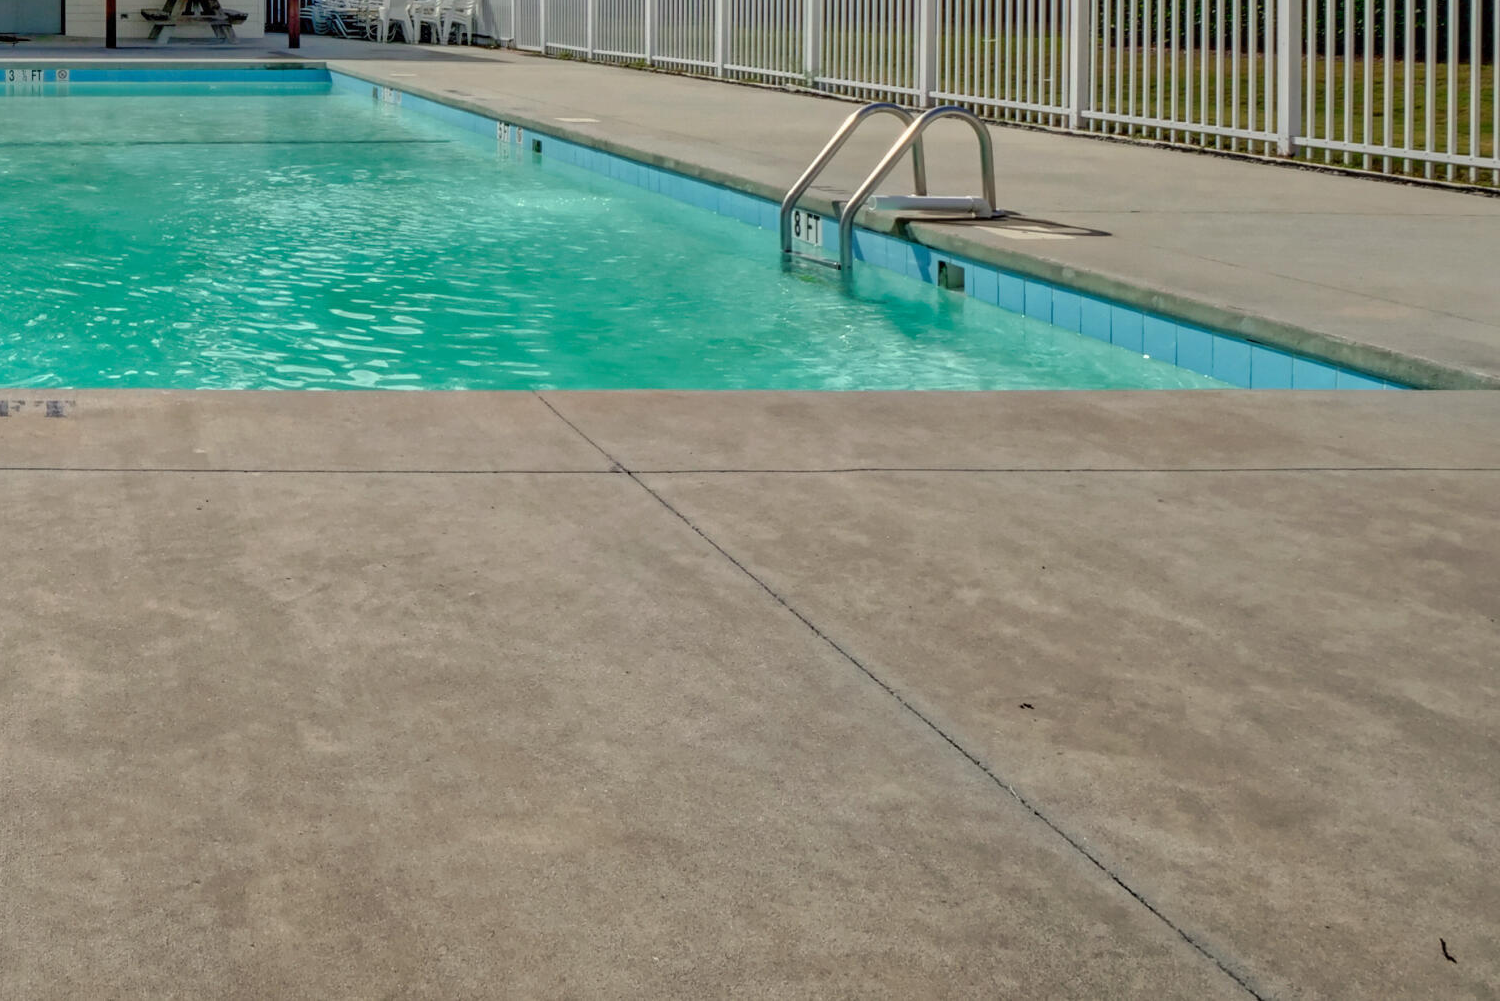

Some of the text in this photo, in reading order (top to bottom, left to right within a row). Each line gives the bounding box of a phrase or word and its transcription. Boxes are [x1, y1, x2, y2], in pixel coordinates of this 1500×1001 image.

[9, 70, 15, 82] 3
[31, 70, 42, 81] FT
[795, 210, 820, 244] 8 FT
